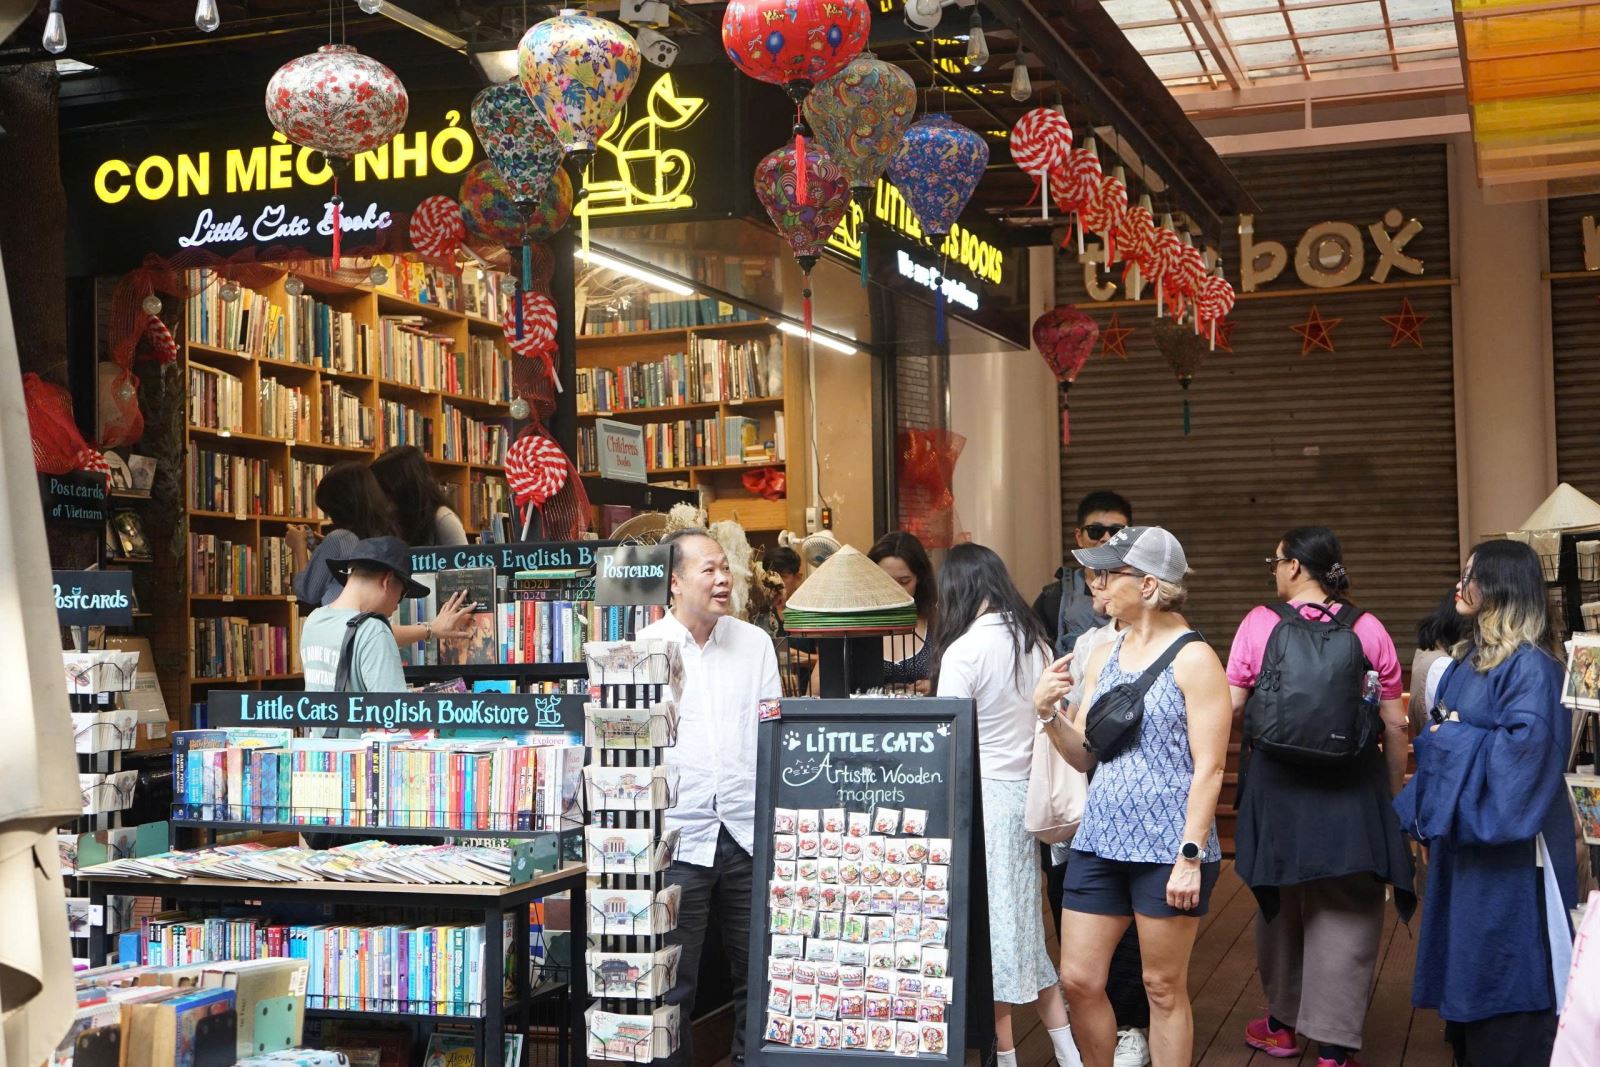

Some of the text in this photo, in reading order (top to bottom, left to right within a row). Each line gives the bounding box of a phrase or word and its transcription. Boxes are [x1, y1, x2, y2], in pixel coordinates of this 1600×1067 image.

[94, 151, 210, 204] CON
[354, 110, 474, 183] NHỎ
[178, 202, 392, 248] Little Cats Books
[876, 178, 921, 239] LITTLE
[961, 228, 1003, 285] BOOKS
[50, 478, 105, 499] Postcards
[52, 504, 103, 520] of Vietnam
[412, 553, 447, 571] ittle
[454, 552, 495, 571] Cats
[503, 548, 572, 570] English
[239, 694, 294, 721] Little
[296, 697, 339, 722] Cats
[347, 697, 432, 728] English
[532, 736, 565, 746] Explorer
[881, 732, 935, 753] CATS
[800, 752, 943, 785] Artistic Wooden
[837, 786, 906, 814] magnets
